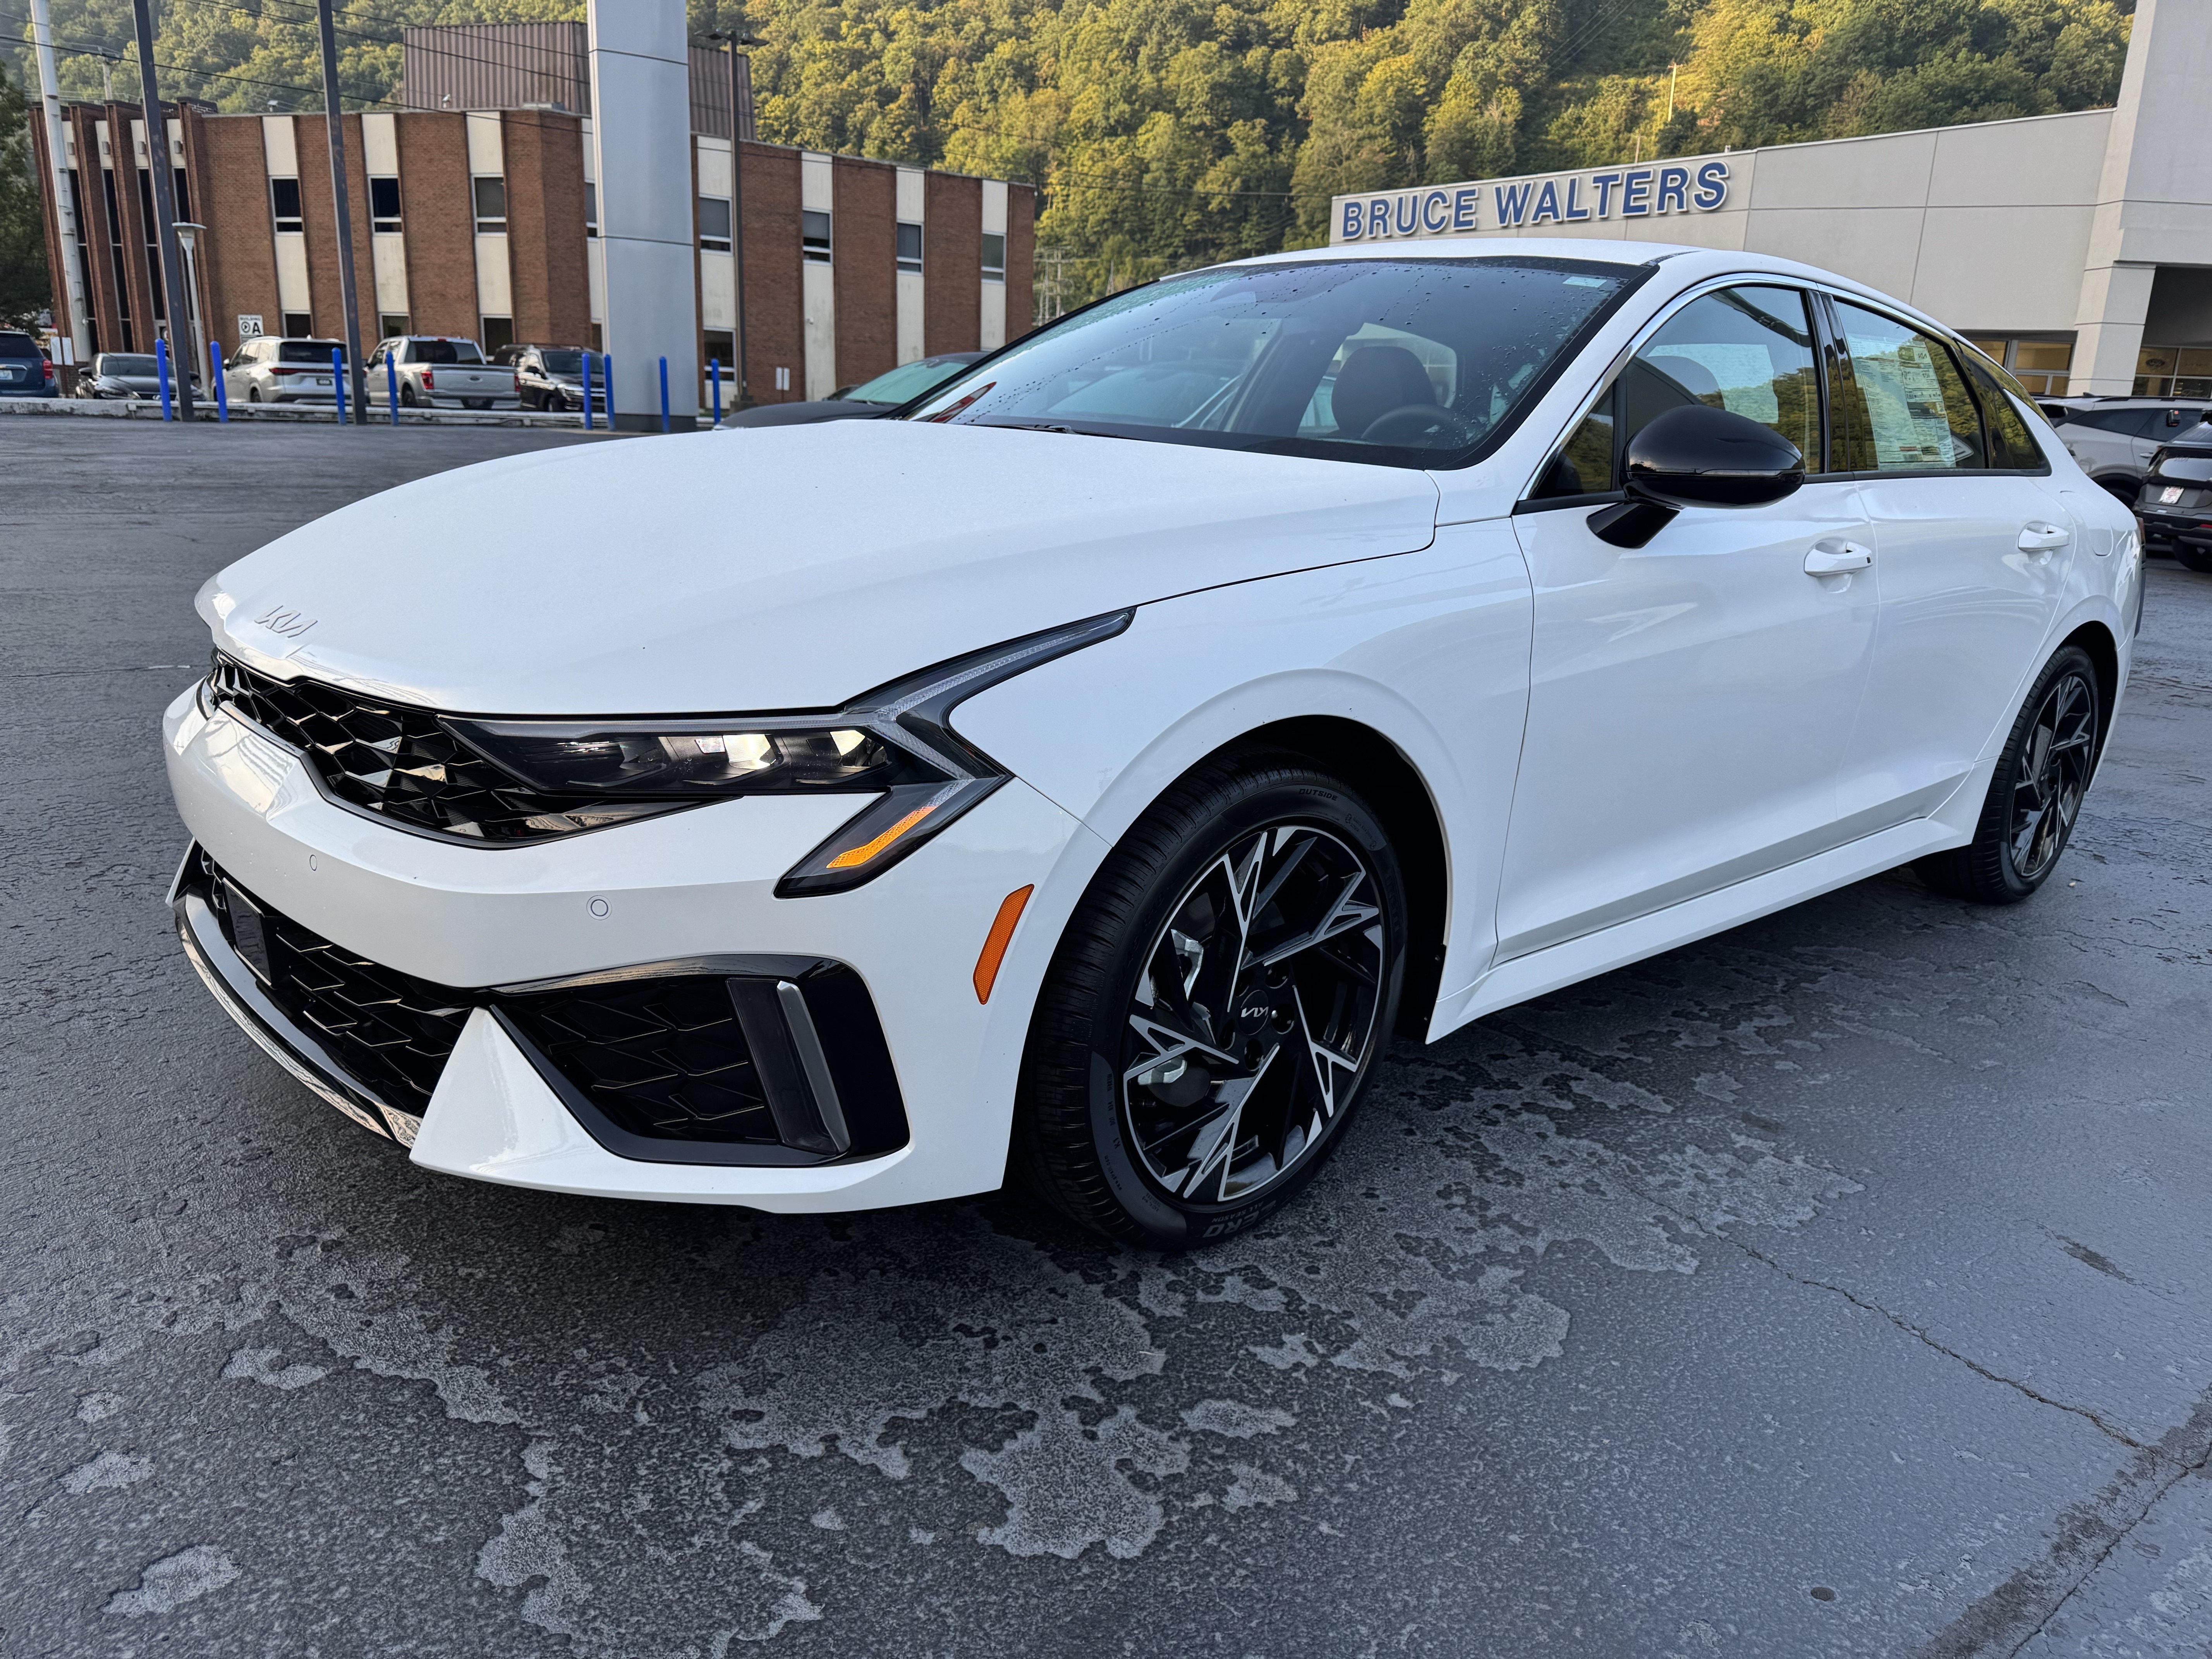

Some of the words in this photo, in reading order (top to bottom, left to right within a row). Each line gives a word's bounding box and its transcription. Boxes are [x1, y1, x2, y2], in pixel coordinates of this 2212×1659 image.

[1342, 187, 1478, 240] BRUCE
[1494, 161, 1729, 226] WALTERS
[252, 322, 261, 333] A
[254, 605, 318, 638] KIA
[1299, 788, 1338, 801] OUTSIDE
[1241, 1006, 1269, 1017] KIA
[1212, 1210, 1247, 1223] SEASON
